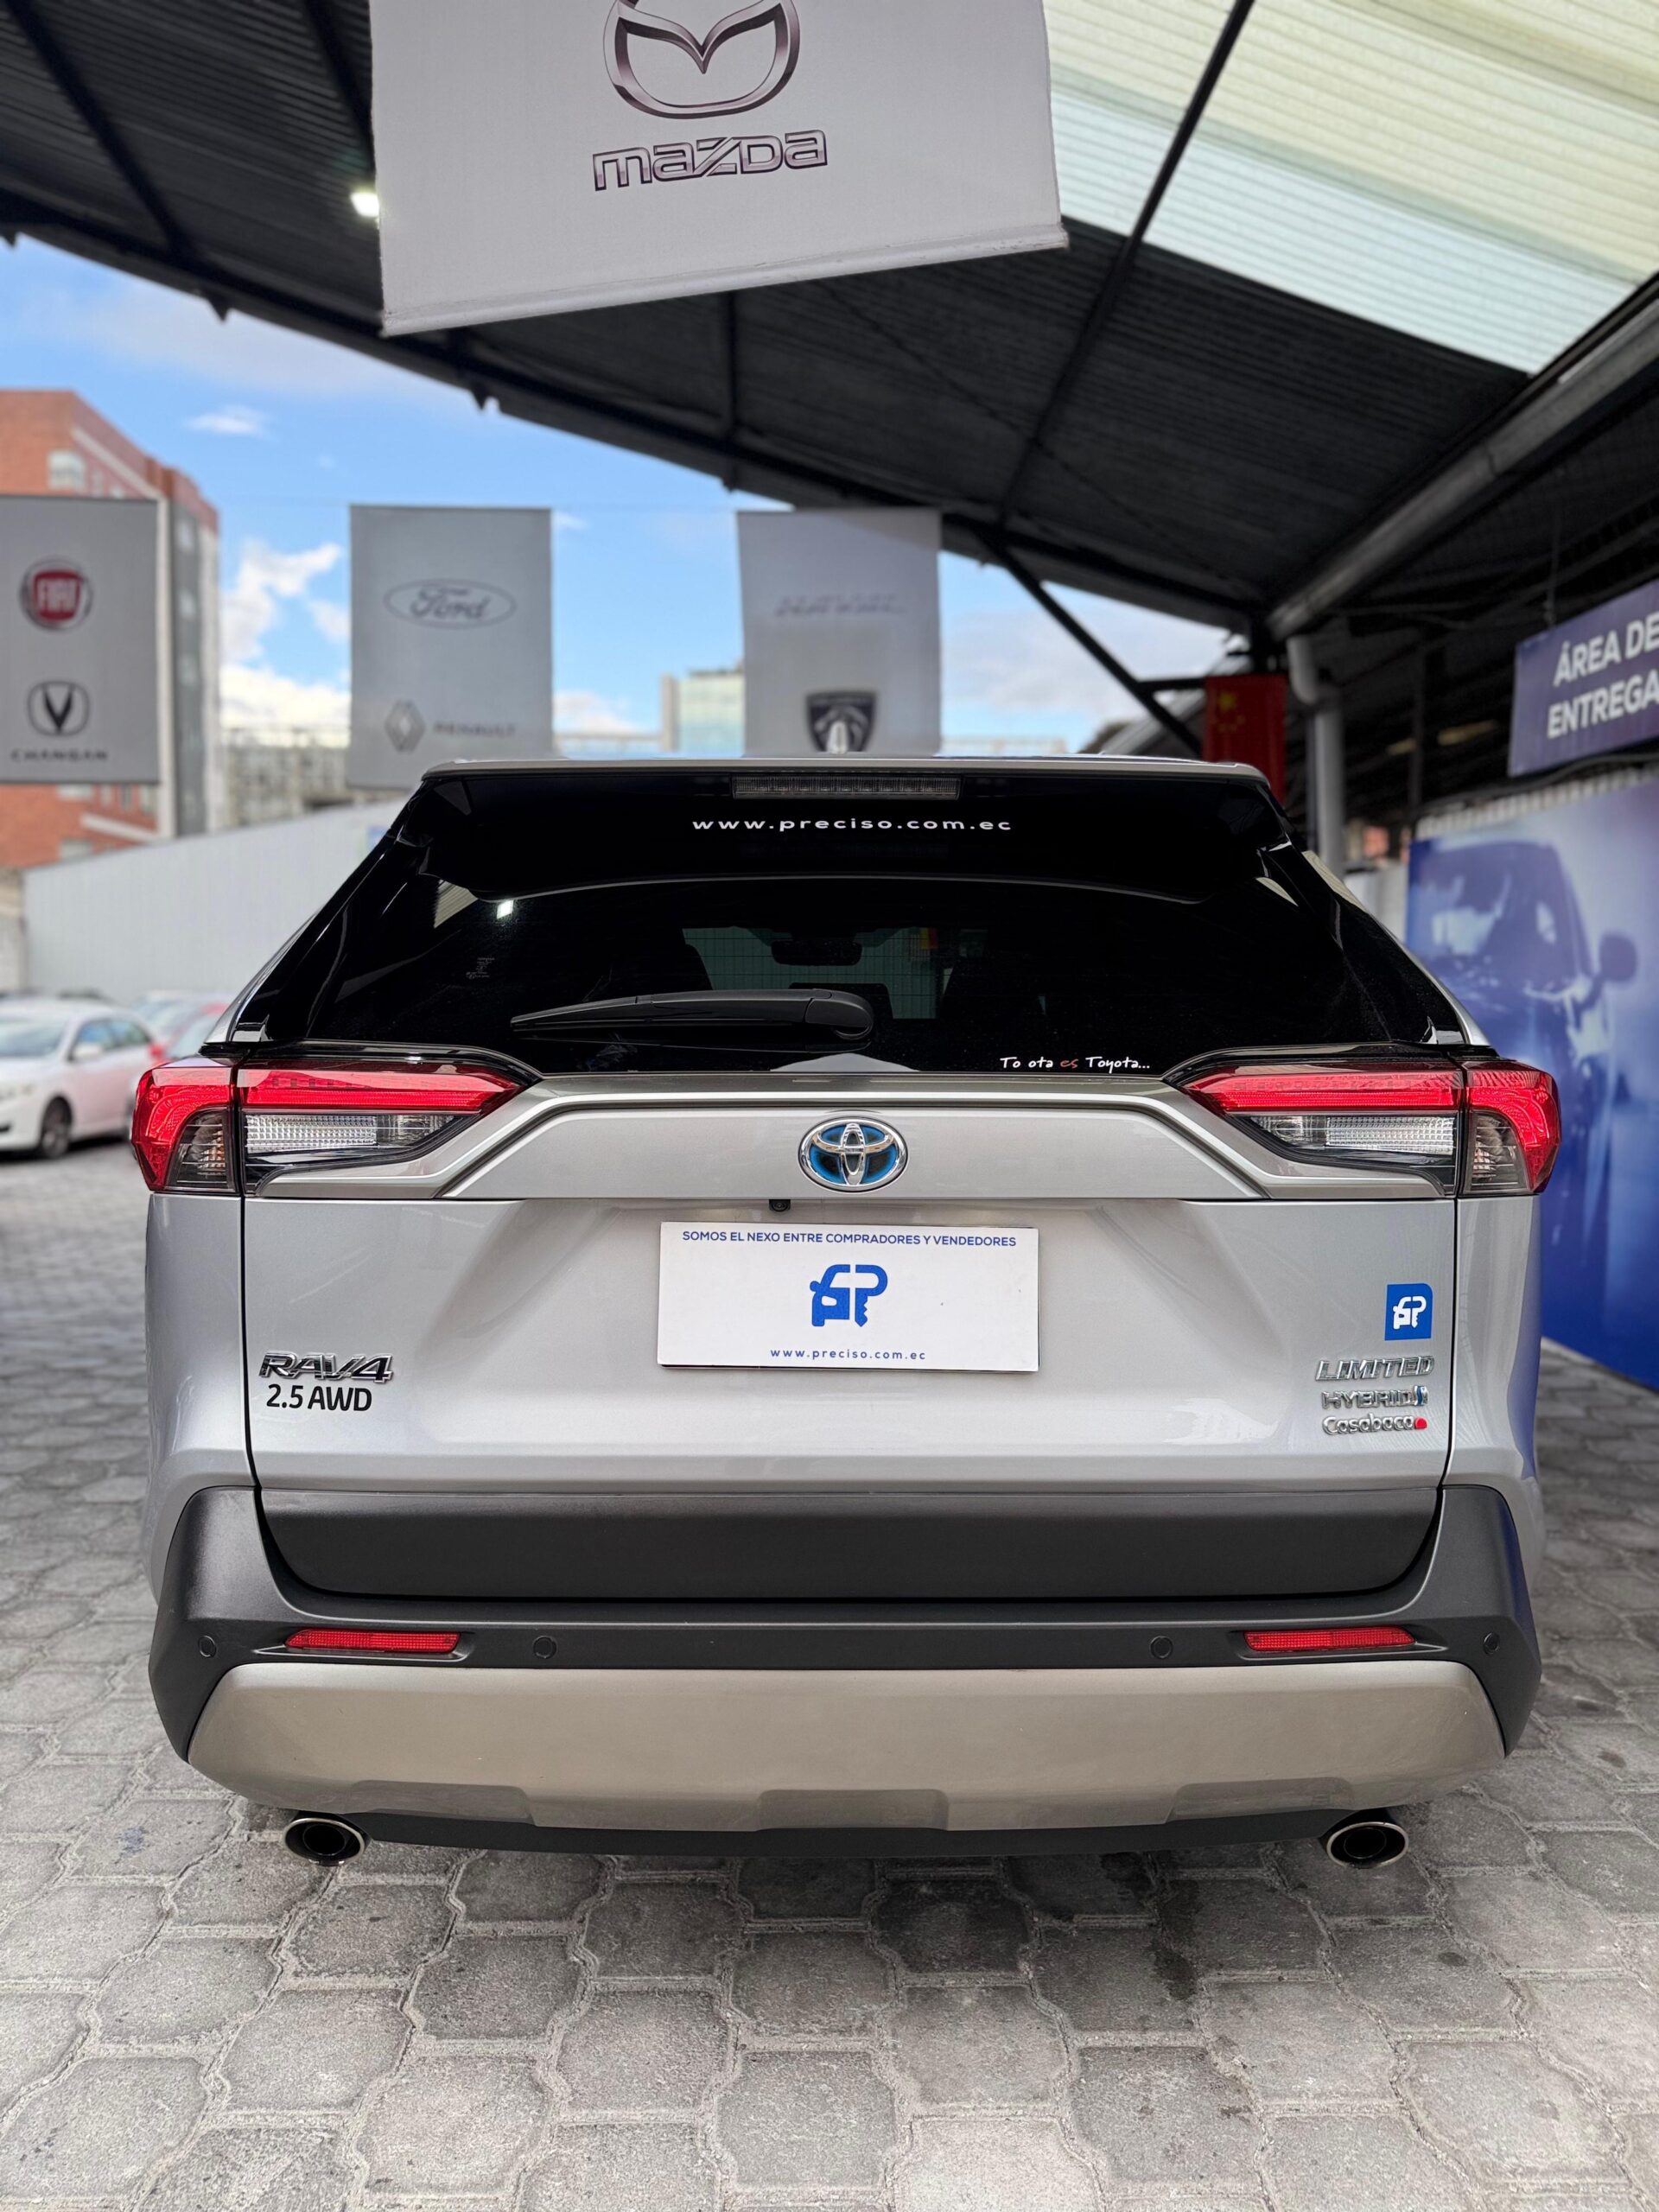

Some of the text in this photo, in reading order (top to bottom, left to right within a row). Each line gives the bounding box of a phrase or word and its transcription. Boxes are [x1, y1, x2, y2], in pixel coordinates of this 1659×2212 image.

[410, 587, 492, 619] Ford
[1553, 611, 1659, 687] ÁREA DE
[1547, 668, 1659, 739] ENTREGA
[692, 817, 1011, 832] www.preciso.com.ec
[1059, 1058, 1079, 1069] es
[682, 1230, 1017, 1247] SOMOS EL NEXO ENTRE COMPRADORES Y VENDEDORES
[259, 1351, 393, 1382] RAV4
[770, 1349, 926, 1361] www.preciso.com.ec
[1315, 1356, 1435, 1382] LIMITED
[266, 1383, 372, 1411] 2.5 AWD
[1321, 1389, 1415, 1409] HYBRID
[1323, 1413, 1414, 1435] Casabaca
